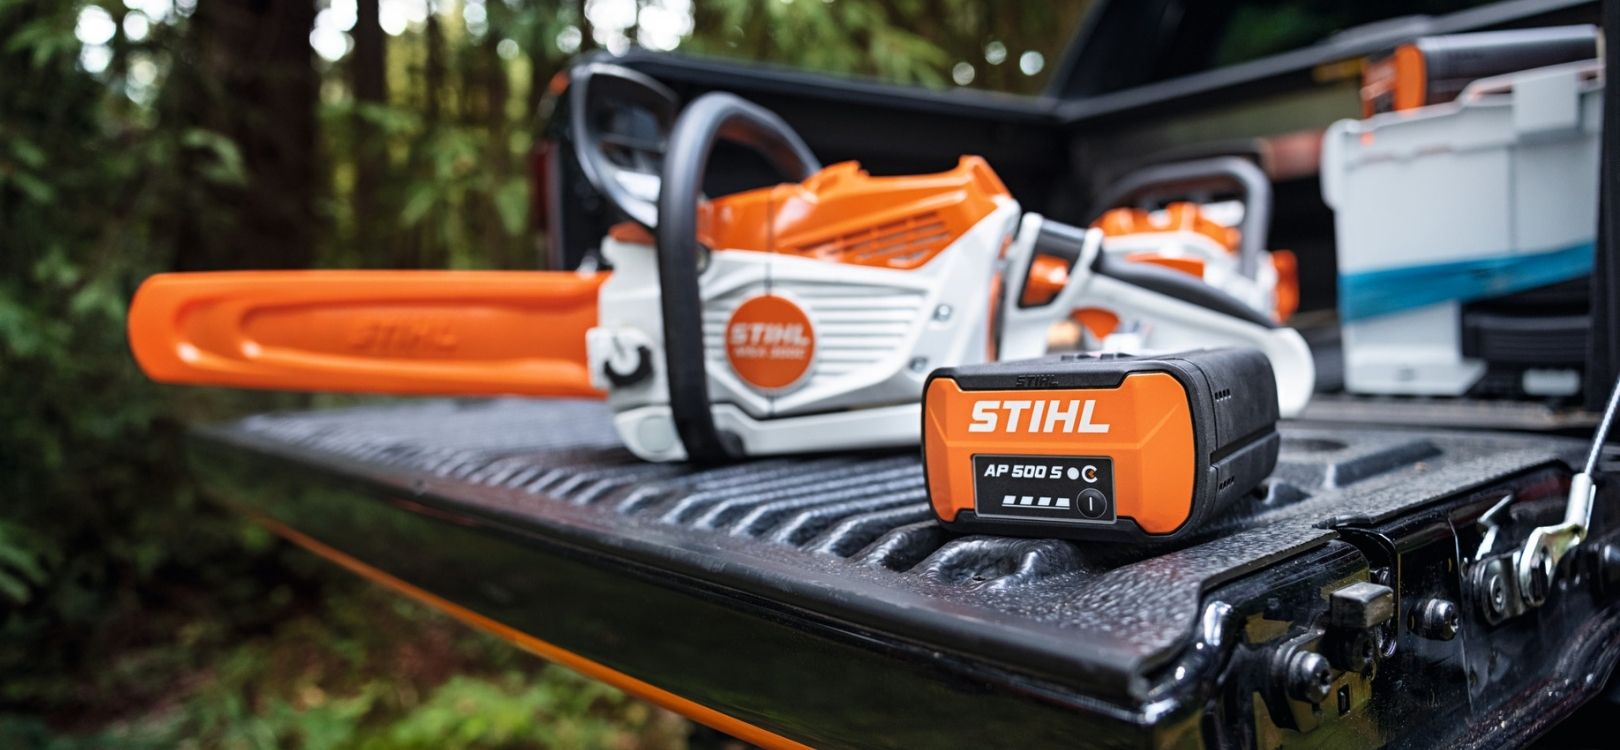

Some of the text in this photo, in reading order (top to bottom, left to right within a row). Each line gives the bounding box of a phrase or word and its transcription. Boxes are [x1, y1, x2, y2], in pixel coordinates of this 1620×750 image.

[730, 322, 811, 346] STIHL
[1016, 374, 1059, 387] STIHL
[968, 399, 1110, 433] STIHL
[984, 464, 1063, 480] AP 500 S
